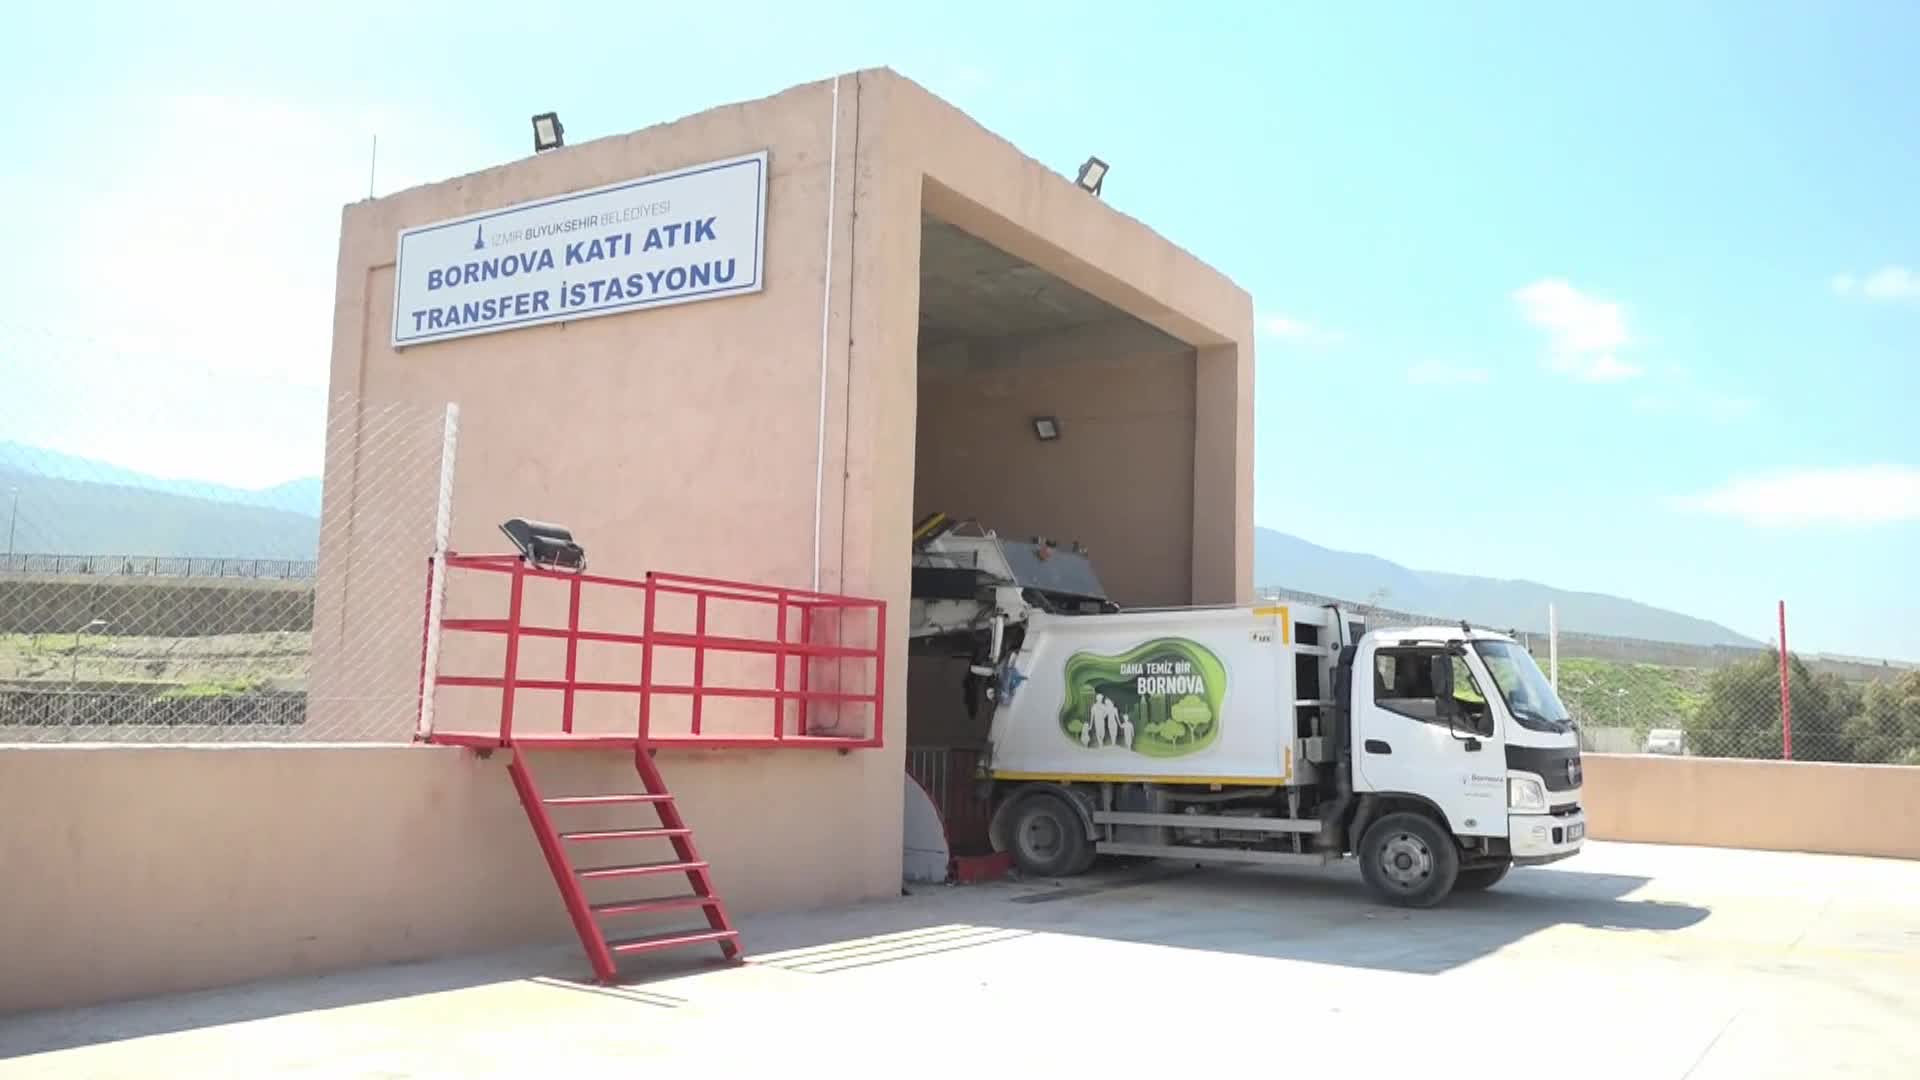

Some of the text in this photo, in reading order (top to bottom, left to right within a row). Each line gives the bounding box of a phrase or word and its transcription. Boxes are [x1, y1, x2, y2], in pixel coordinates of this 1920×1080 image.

[428, 217, 717, 290] BORNOVA KATI ATIK
[412, 259, 737, 332] TRANSFER İSTASYONU
[1120, 663, 1144, 675] DAHA
[1137, 675, 1205, 695] BORNOVA
